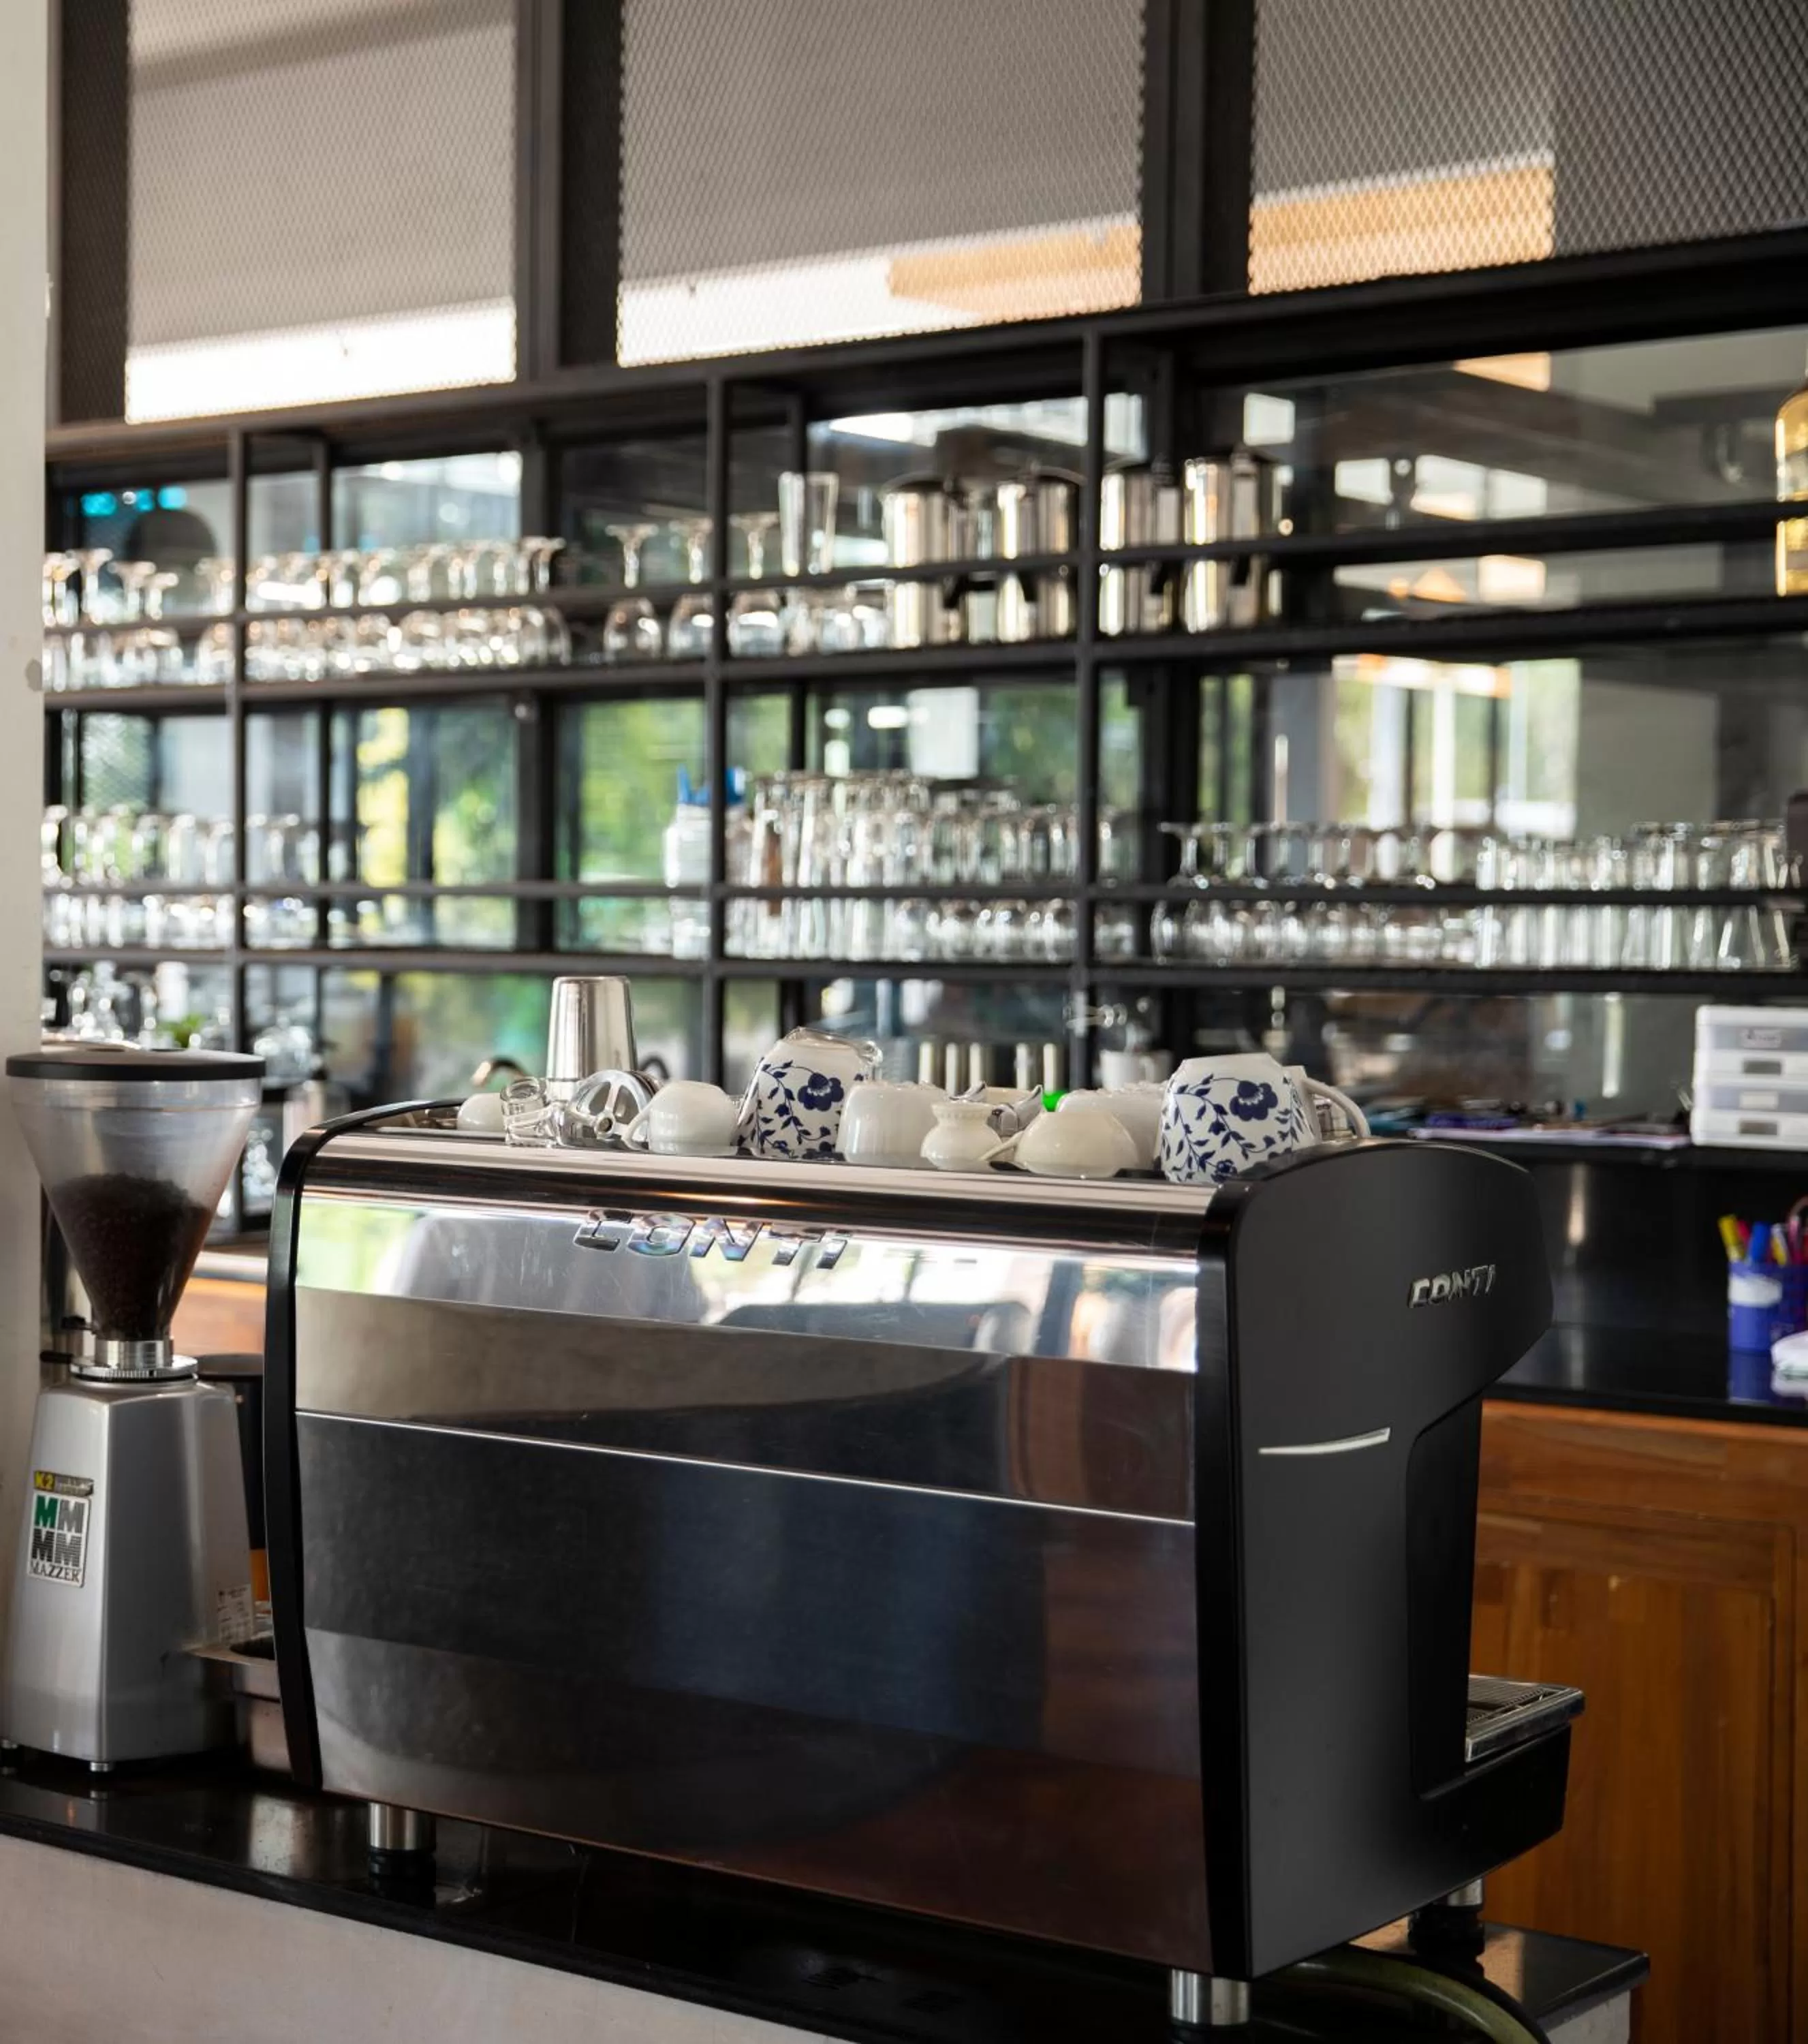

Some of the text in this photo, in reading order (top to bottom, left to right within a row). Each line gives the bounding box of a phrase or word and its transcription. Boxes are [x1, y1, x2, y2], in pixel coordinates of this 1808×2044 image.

[574, 1209, 852, 1269] CONTI
[1408, 1265, 1495, 1308] CONTI
[30, 1559, 80, 1582] MAZZER
